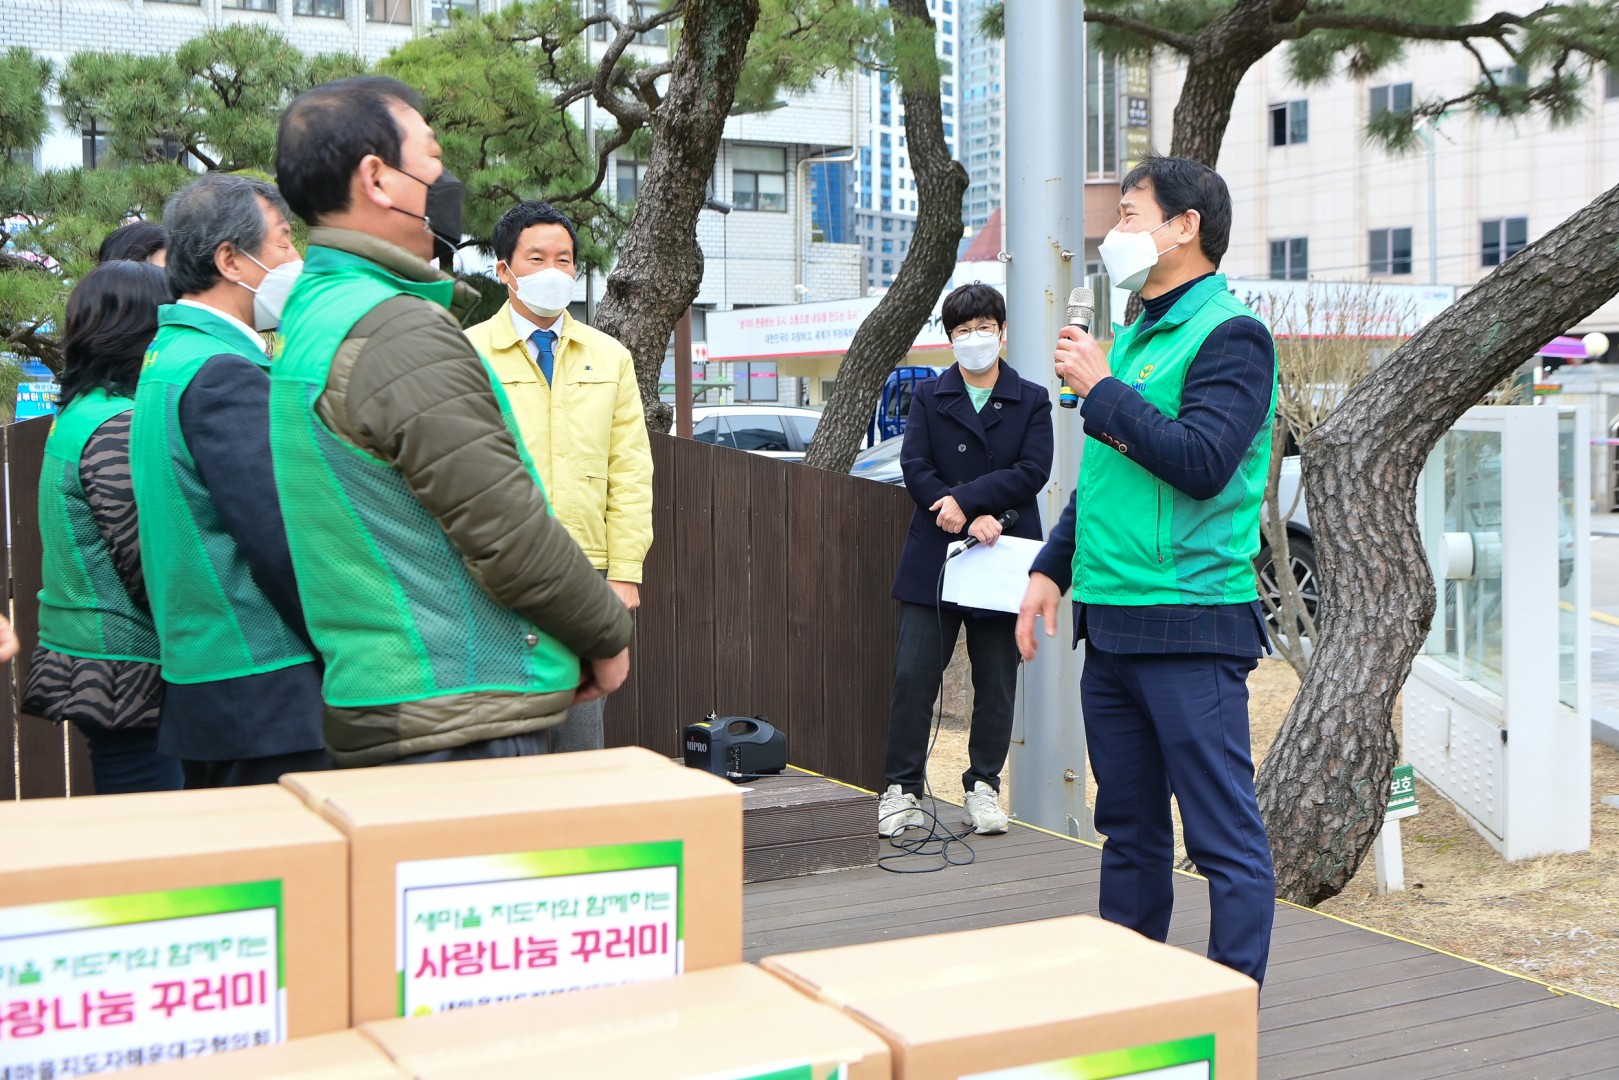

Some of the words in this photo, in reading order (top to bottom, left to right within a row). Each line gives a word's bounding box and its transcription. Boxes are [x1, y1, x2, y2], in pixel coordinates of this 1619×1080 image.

[414, 904, 482, 932] 새마을
[490, 897, 579, 924] 지도자와
[585, 891, 671, 917] 함께하는
[52, 947, 159, 978] 지도자와
[168, 936, 268, 967] 함께하는
[414, 936, 558, 979] 사랑나눔
[571, 922, 669, 964] 꾸러미
[0, 990, 135, 1038] 랑나눔
[150, 969, 267, 1018] 꾸러미
